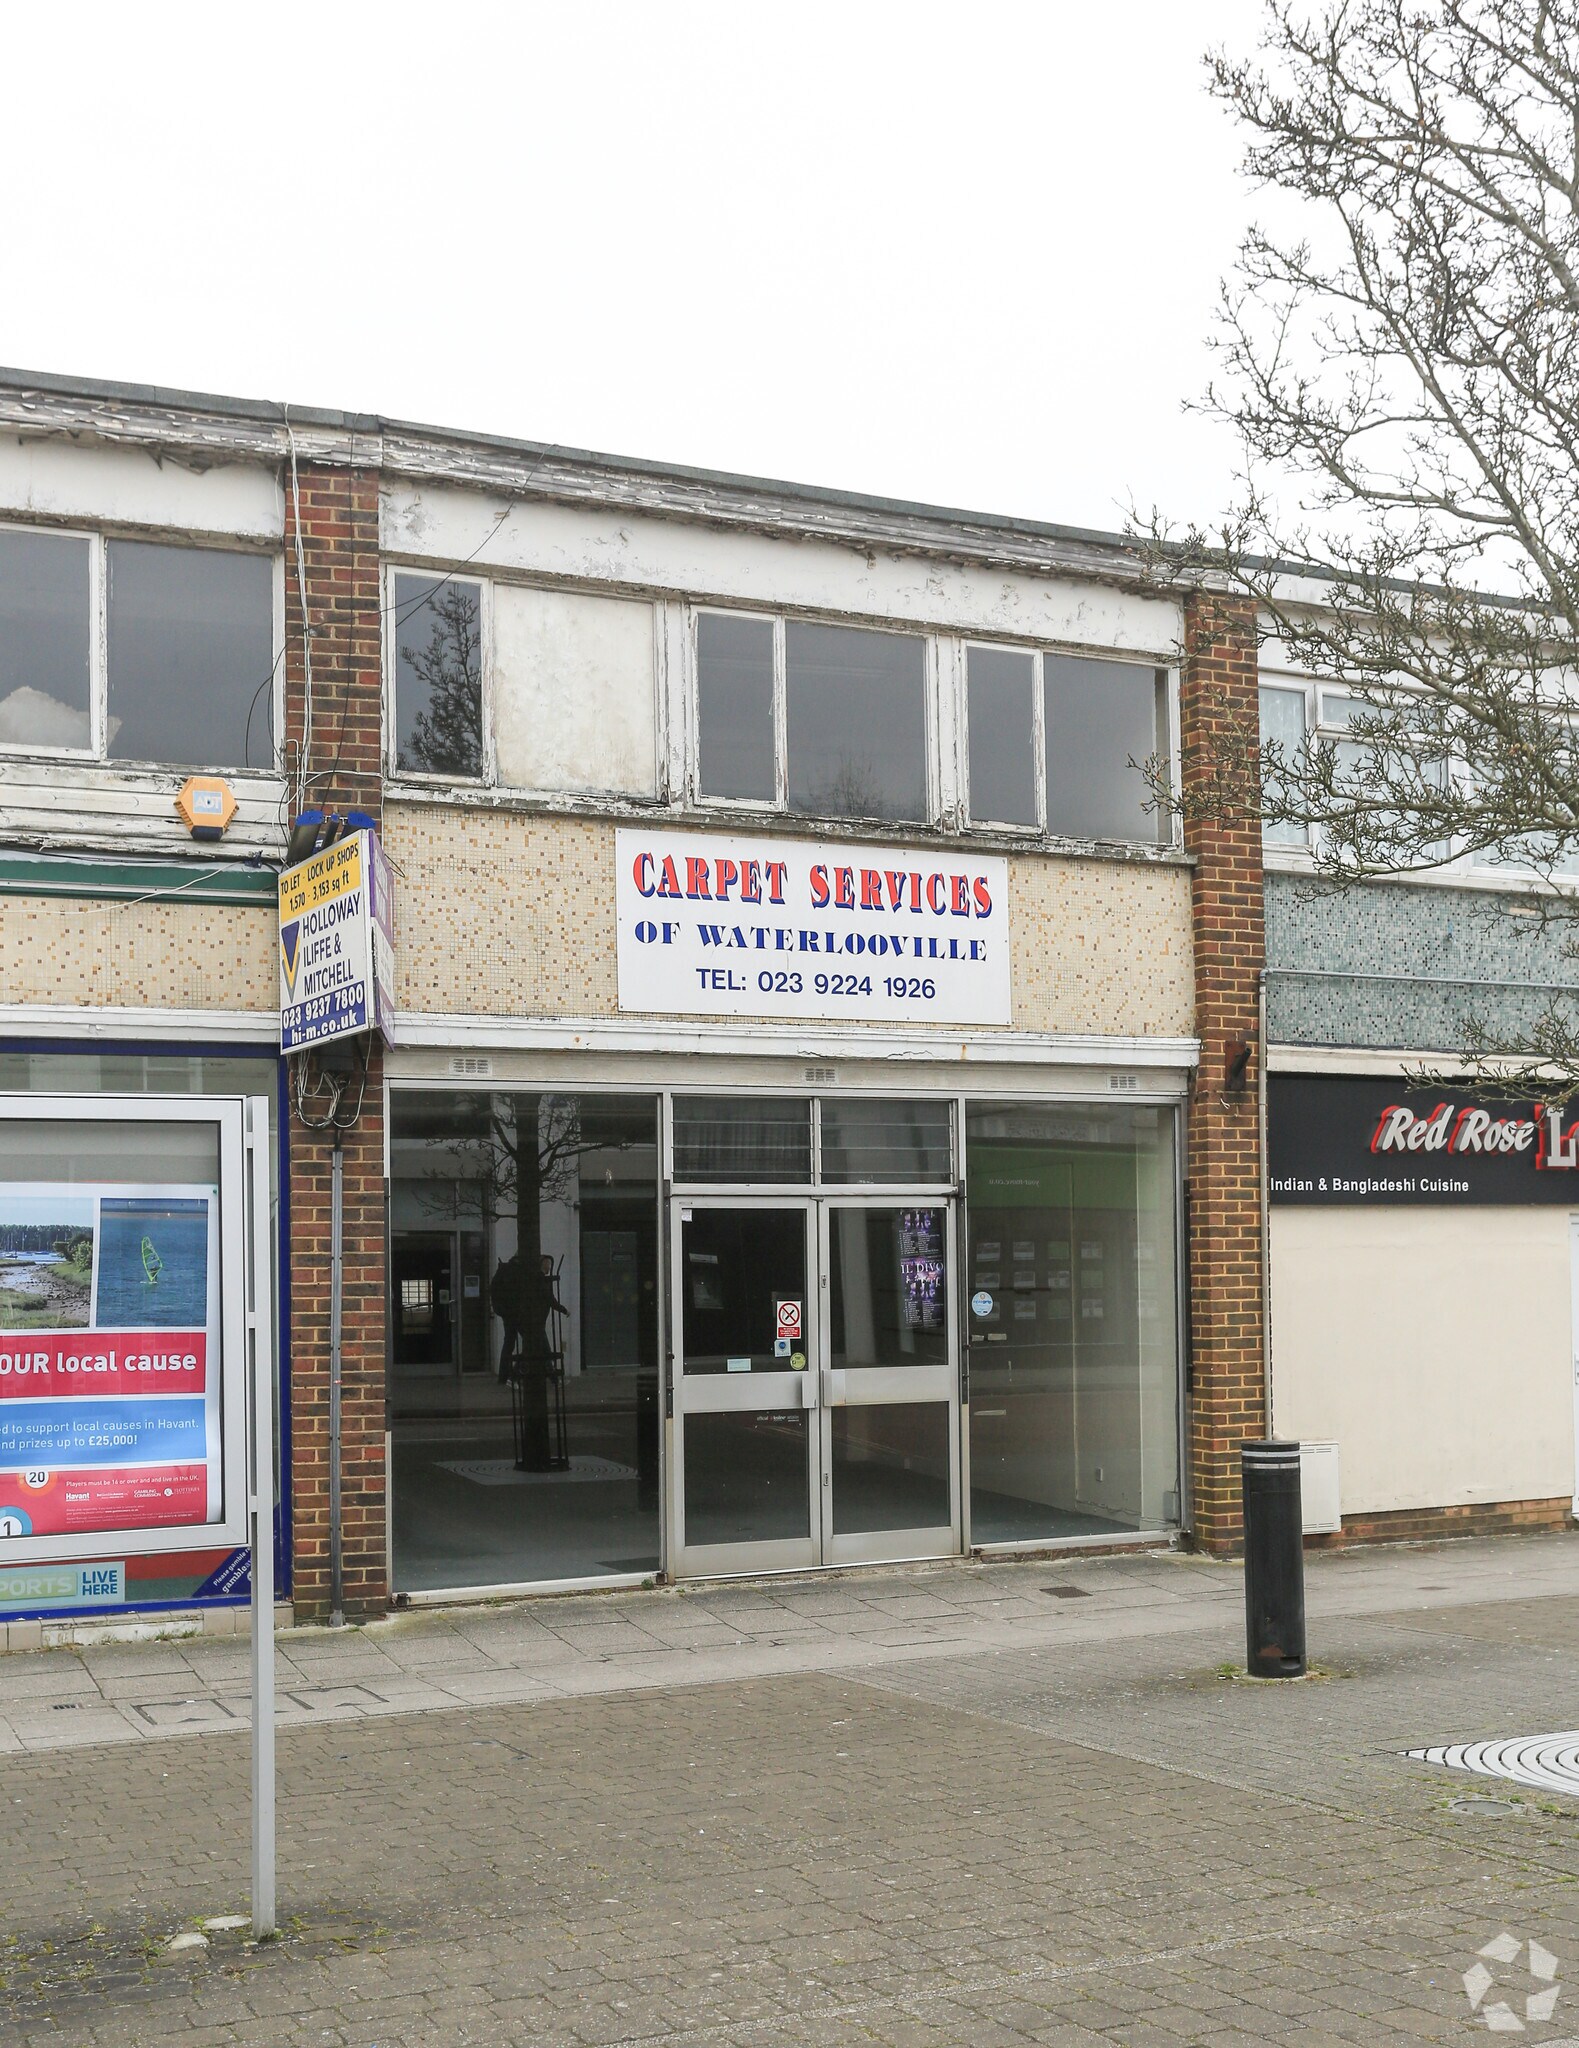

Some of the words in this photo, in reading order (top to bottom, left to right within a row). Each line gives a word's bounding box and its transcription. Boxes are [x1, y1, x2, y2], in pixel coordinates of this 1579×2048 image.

[281, 880, 289, 895] TO
[290, 873, 300, 891] LET
[307, 860, 324, 882] LOCK
[326, 855, 335, 872] UP
[337, 842, 359, 867] SHOPS
[290, 891, 306, 912] 1,570
[313, 879, 330, 901] 3,153
[332, 877, 340, 891] sq
[342, 869, 349, 886] ft
[633, 852, 789, 905] CARPET
[809, 864, 993, 920] SERVICES
[303, 891, 361, 938] HOLLOWAY
[303, 936, 332, 968] ILIFFE
[334, 932, 342, 955] &
[634, 920, 681, 945] OF
[696, 924, 987, 961] WATERLOOVILLE
[304, 958, 354, 997] MITCHELL
[696, 968, 747, 991] TEL:
[758, 971, 804, 993] 023
[814, 973, 873, 997] 9224
[882, 977, 936, 1000] 1926
[283, 1006, 302, 1030] 023
[305, 994, 331, 1022] 9237
[335, 983, 364, 1012] 7800
[291, 1009, 358, 1045] hi-m.co.uk
[1371, 1103, 1455, 1153] Red
[1448, 1107, 1535, 1154] Rose
[1534, 1104, 1579, 1171] L
[1270, 1177, 1314, 1192] Indian
[1318, 1178, 1328, 1191] &
[1332, 1178, 1416, 1195] Bangladeshi
[1420, 1178, 1469, 1192] Cuisine
[901, 1264, 913, 1274] IL
[916, 1262, 944, 1273] DIVO
[57, 1351, 118, 1373] local
[124, 1354, 197, 1373] cause
[12, 1424, 23, 1434] to
[26, 1422, 70, 1435] support
[73, 1420, 100, 1432] local
[103, 1421, 142, 1431] causes
[144, 1418, 155, 1429] in
[158, 1417, 199, 1430] Havant.
[19, 1438, 54, 1451] prizes
[57, 1438, 71, 1449] up
[74, 1435, 86, 1446] to
[88, 1435, 138, 1447] £25,000!
[29, 1471, 46, 1483] 20
[66, 1492, 90, 1500] Havant
[3, 1520, 11, 1536] 1
[82, 1570, 118, 1583] LIVE
[213, 1569, 230, 1587] Please
[228, 1551, 247, 1572] gamble
[82, 1583, 118, 1596] HERE
